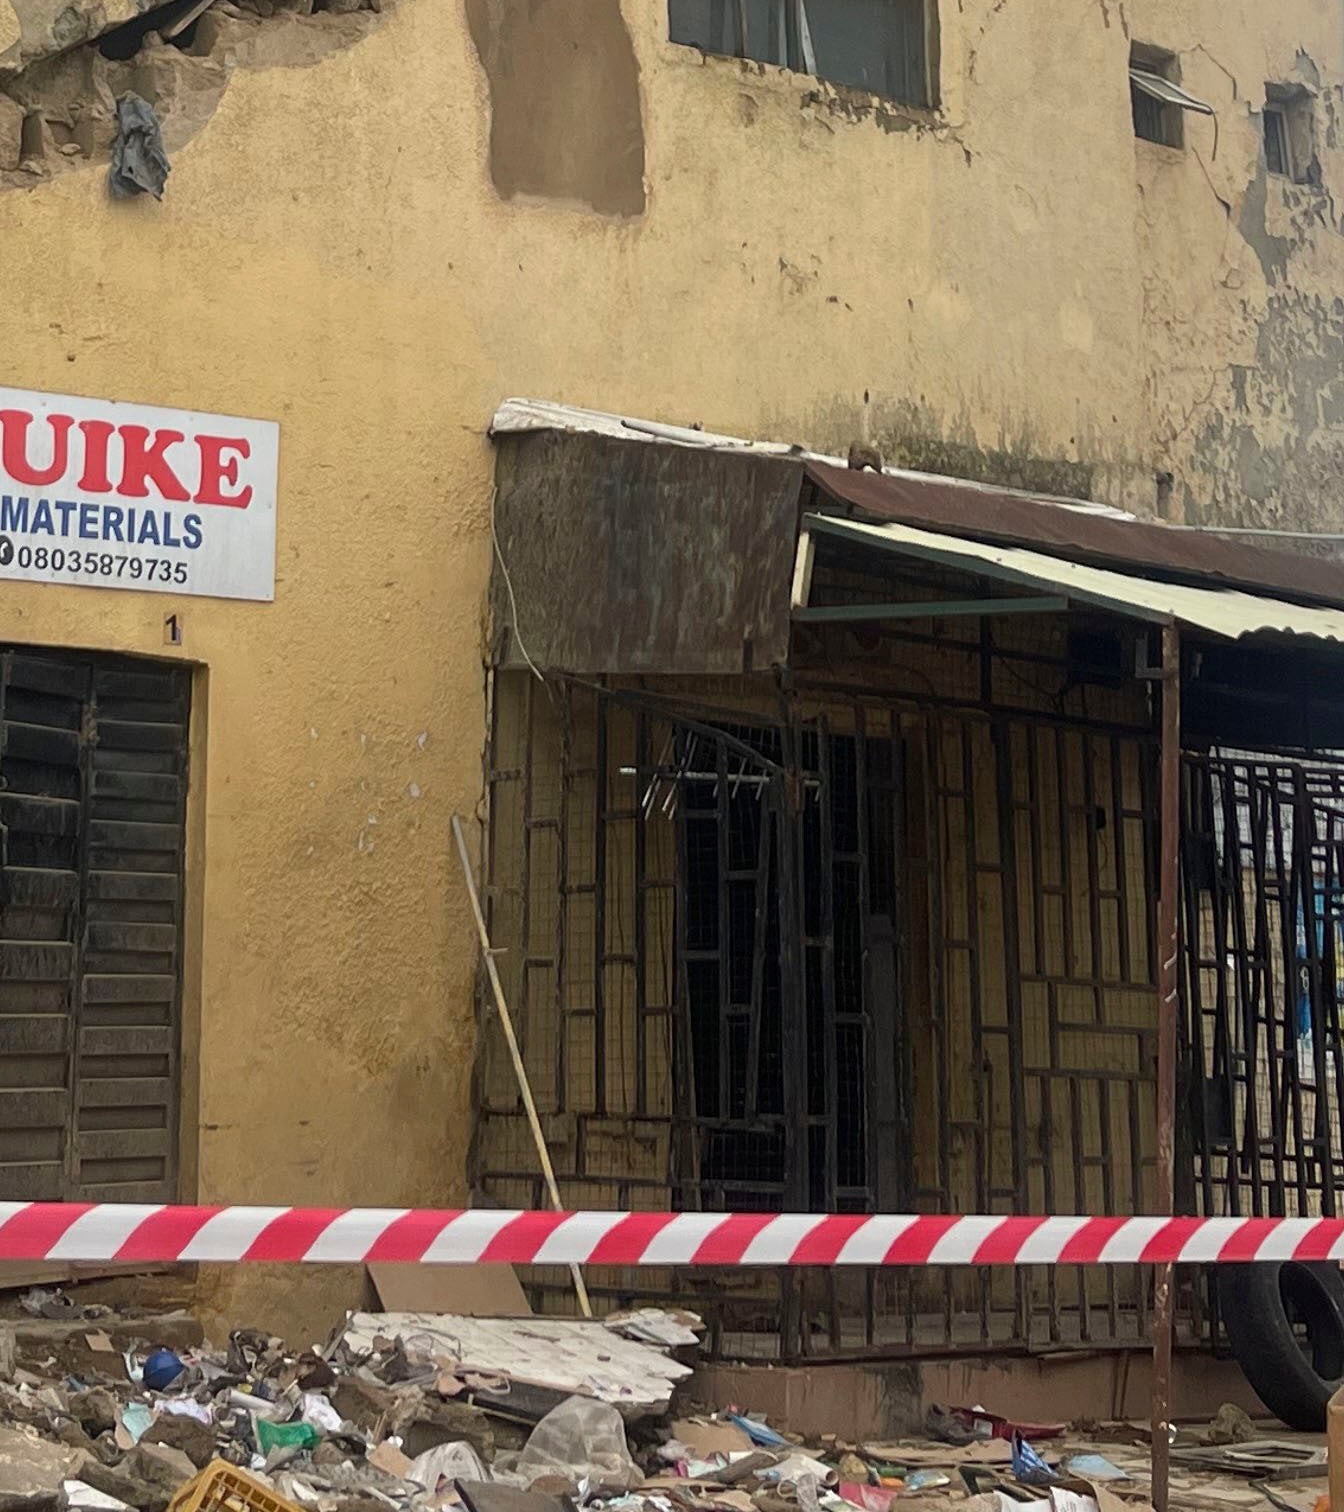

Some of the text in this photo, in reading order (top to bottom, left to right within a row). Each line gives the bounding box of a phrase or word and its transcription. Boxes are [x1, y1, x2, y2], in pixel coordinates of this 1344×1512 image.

[0, 495, 204, 550] MATERIALS
[17, 545, 188, 584] 08035879735
[165, 613, 177, 641] 1
